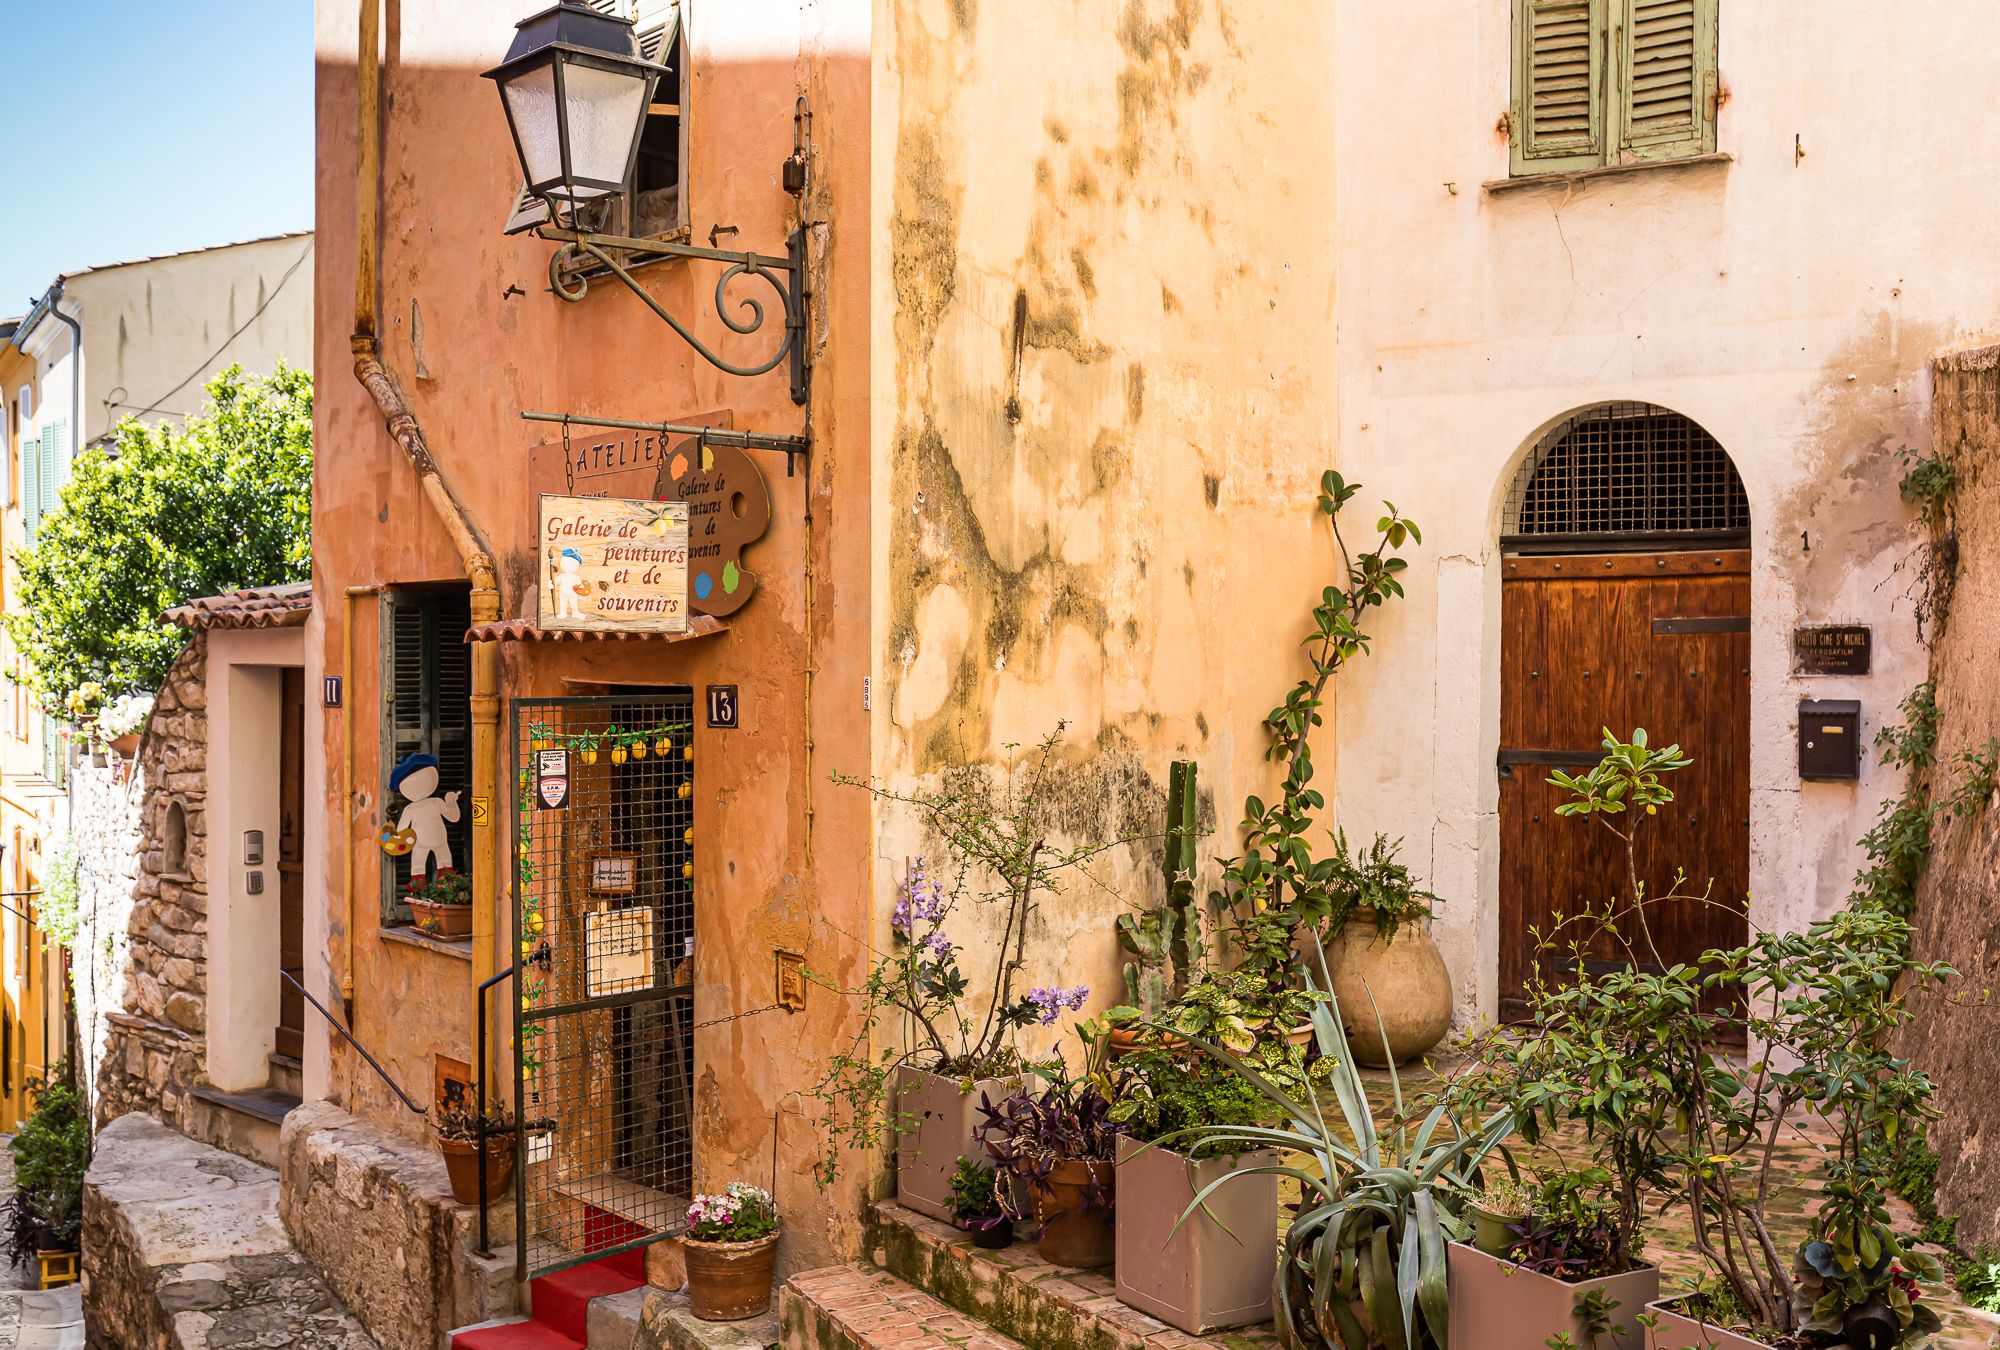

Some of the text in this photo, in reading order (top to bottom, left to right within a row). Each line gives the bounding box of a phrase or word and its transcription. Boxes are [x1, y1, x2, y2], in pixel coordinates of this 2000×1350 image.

[678, 473, 725, 502] Galerie de
[690, 500, 721, 516] intures
[547, 516, 638, 541] Galerie de
[705, 517, 716, 535] de
[688, 541, 720, 559] uvenirs
[1801, 531, 1810, 551] 1
[602, 543, 684, 566] peintures
[614, 565, 662, 585] et de
[597, 595, 678, 612] souvenirs
[1797, 633, 1817, 646] PHOTO
[1844, 633, 1865, 646] MICHEL
[326, 680, 336, 702] 11
[711, 691, 732, 721] 13
